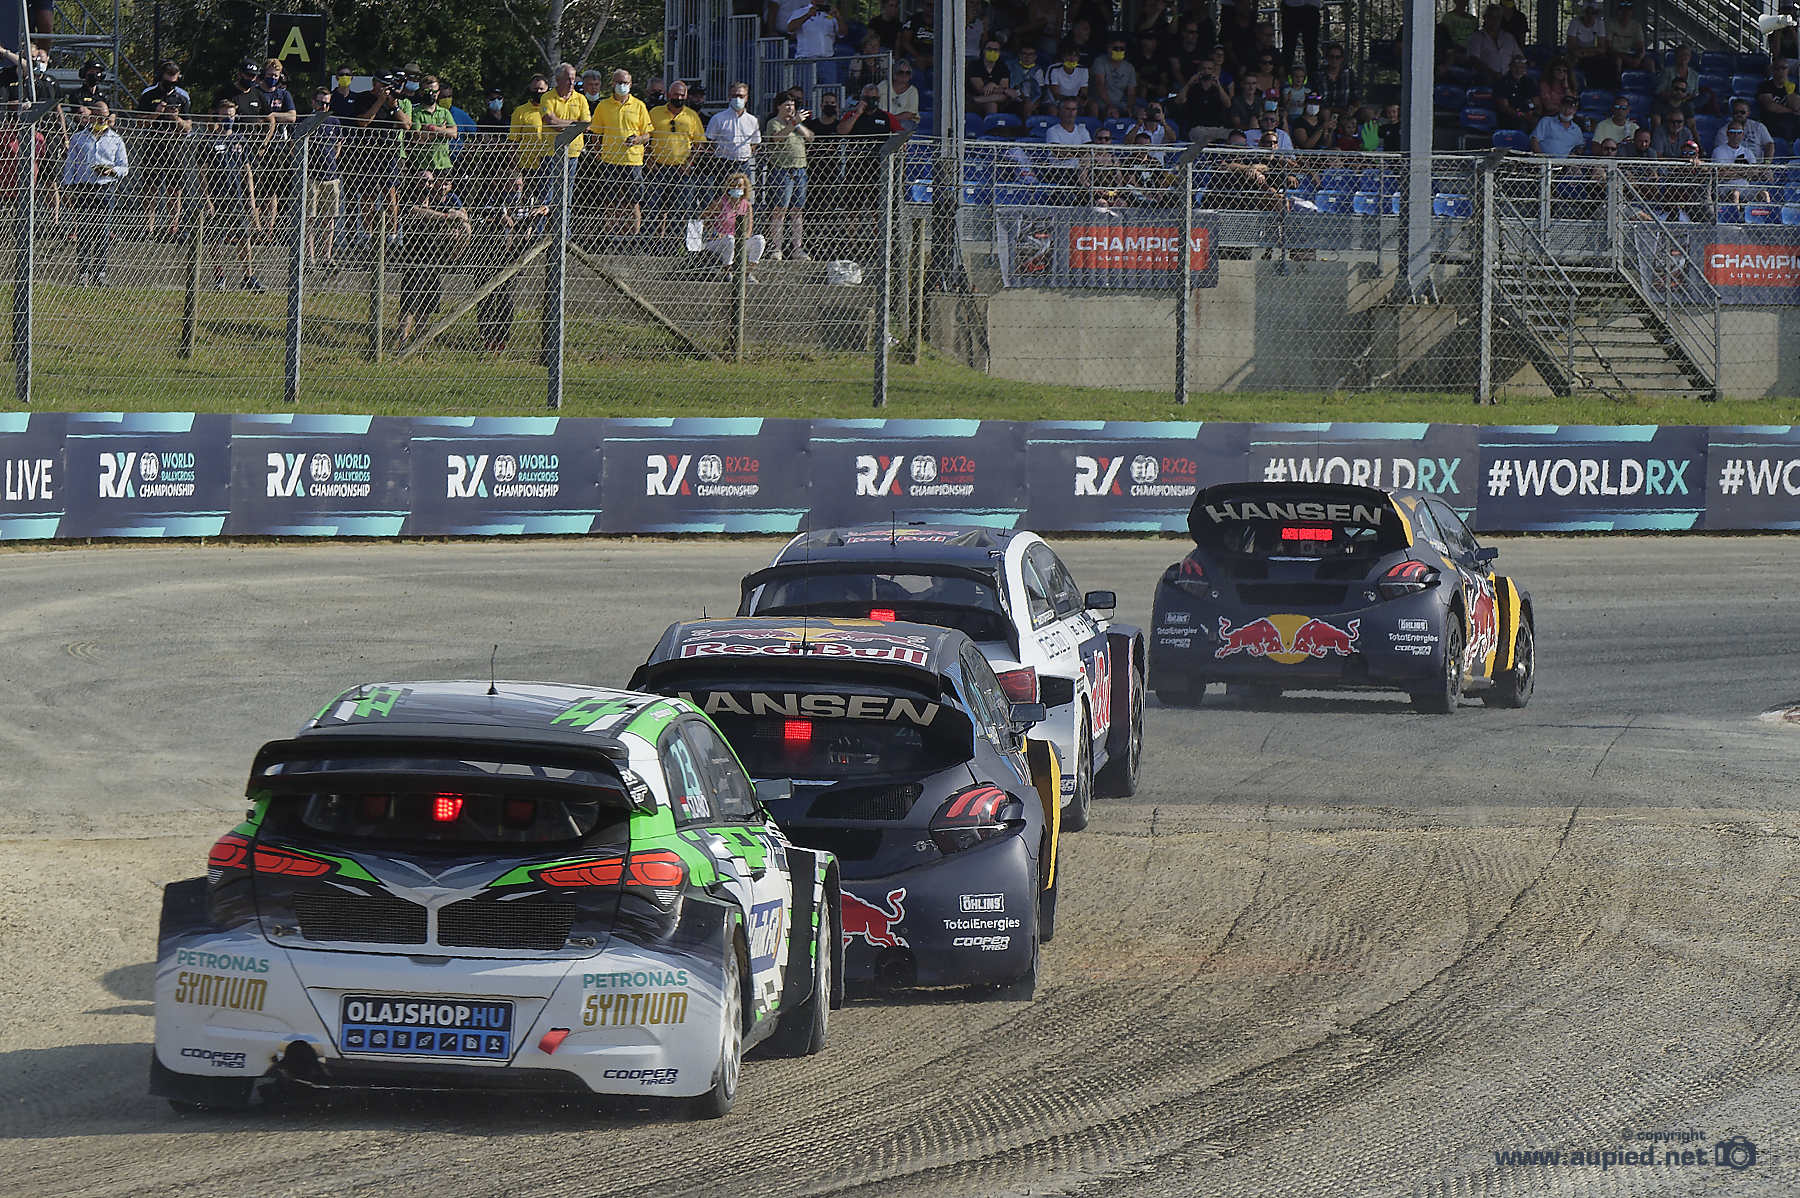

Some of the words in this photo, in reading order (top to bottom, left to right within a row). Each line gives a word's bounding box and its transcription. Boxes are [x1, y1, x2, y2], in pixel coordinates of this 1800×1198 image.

[278, 26, 310, 62] A
[1711, 254, 1800, 270] CHAMPI
[161, 453, 195, 468] WORLD
[335, 454, 371, 469] WORLD
[519, 455, 559, 469] WORLD
[725, 456, 760, 472] RX2e
[941, 456, 976, 472] RX2e
[1161, 457, 1198, 474] RX2e
[5, 459, 53, 500] LIVE
[99, 452, 137, 498] RX
[161, 471, 195, 481] RALLYCROSS
[267, 452, 306, 497] RX
[334, 471, 371, 481] RALLYCROSS
[447, 455, 489, 498] RX
[518, 473, 559, 482] RALLYCROSS
[646, 454, 692, 496] RX
[855, 455, 904, 496] RX
[1074, 455, 1124, 496] RX
[1487, 458, 1690, 496] #WORLDRX
[139, 484, 195, 499] CHAMPIONSHIP
[310, 484, 371, 497] CHAMPIONSHIP
[493, 485, 559, 497] CHAMPIONSHIP
[1205, 502, 1382, 526] HANSEN
[677, 691, 940, 727] ANSEN
[943, 917, 1020, 931] TotalEnergies
[952, 936, 1010, 947] COOPER
[177, 949, 270, 973] PETRONAS
[583, 970, 689, 989] PETRONAS
[175, 971, 268, 1012] SYNTIUM
[347, 1001, 506, 1029] OLAJSHOP.HU
[583, 992, 689, 1026] SYNTIUM
[181, 1048, 247, 1062] COOPER
[603, 1068, 679, 1079] COOPER
